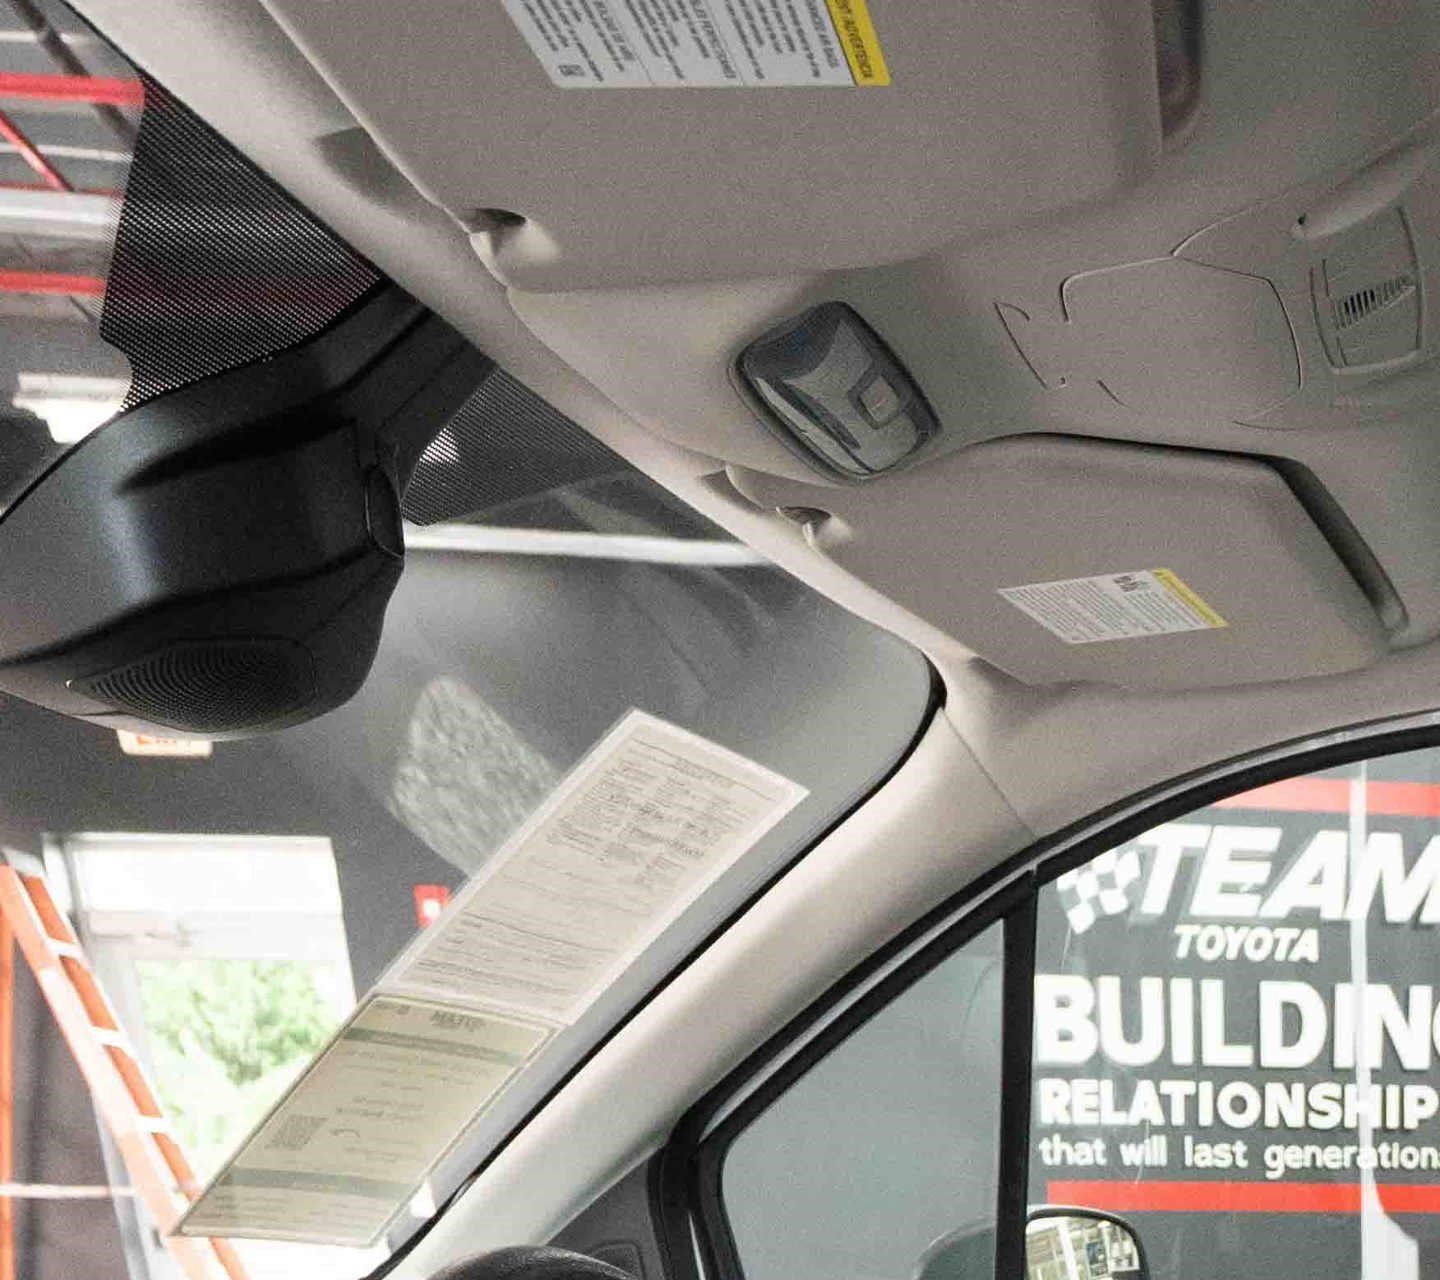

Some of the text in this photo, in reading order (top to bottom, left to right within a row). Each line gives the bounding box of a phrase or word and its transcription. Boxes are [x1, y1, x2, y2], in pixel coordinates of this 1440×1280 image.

[1173, 924, 1320, 963] TOYOTA
[1039, 1136, 1106, 1167] that
[1120, 1136, 1167, 1168] will
[1184, 1137, 1248, 1169] last
